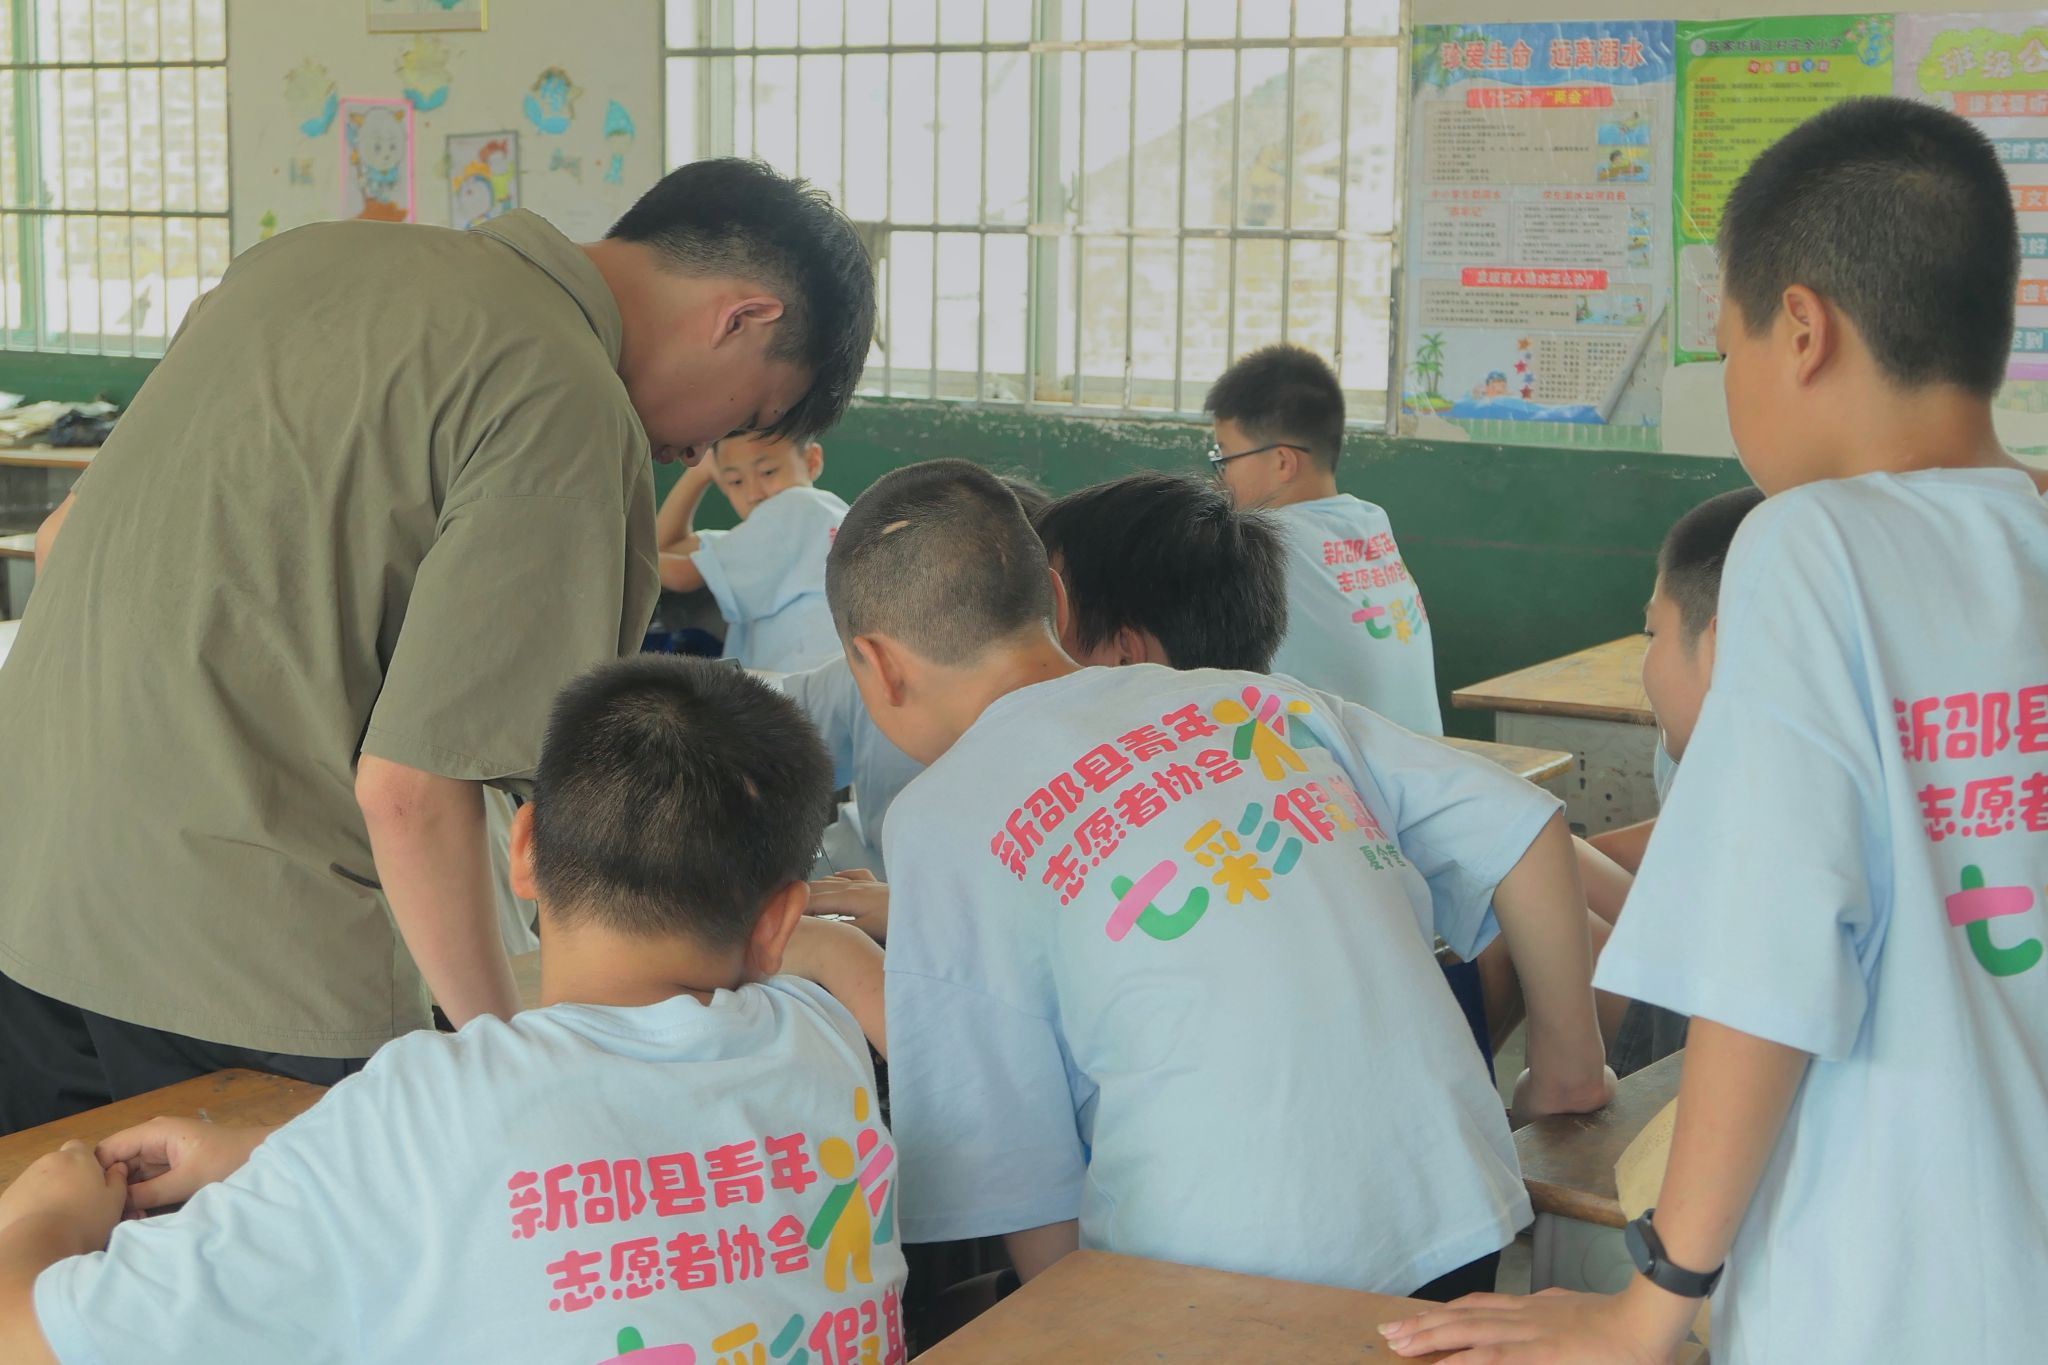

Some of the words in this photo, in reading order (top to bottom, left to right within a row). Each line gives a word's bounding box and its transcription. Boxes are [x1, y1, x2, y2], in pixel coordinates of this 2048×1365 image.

[1440, 39, 1532, 70] 珍爱生命
[1550, 37, 1645, 69] 远离溺水
[990, 703, 1221, 882] 新邵县青年
[1042, 749, 1245, 907] 志愿者协会
[1945, 864, 2048, 978] 七
[507, 1131, 818, 1241] 新邵县青年
[545, 1214, 810, 1314] 志愿者协会
